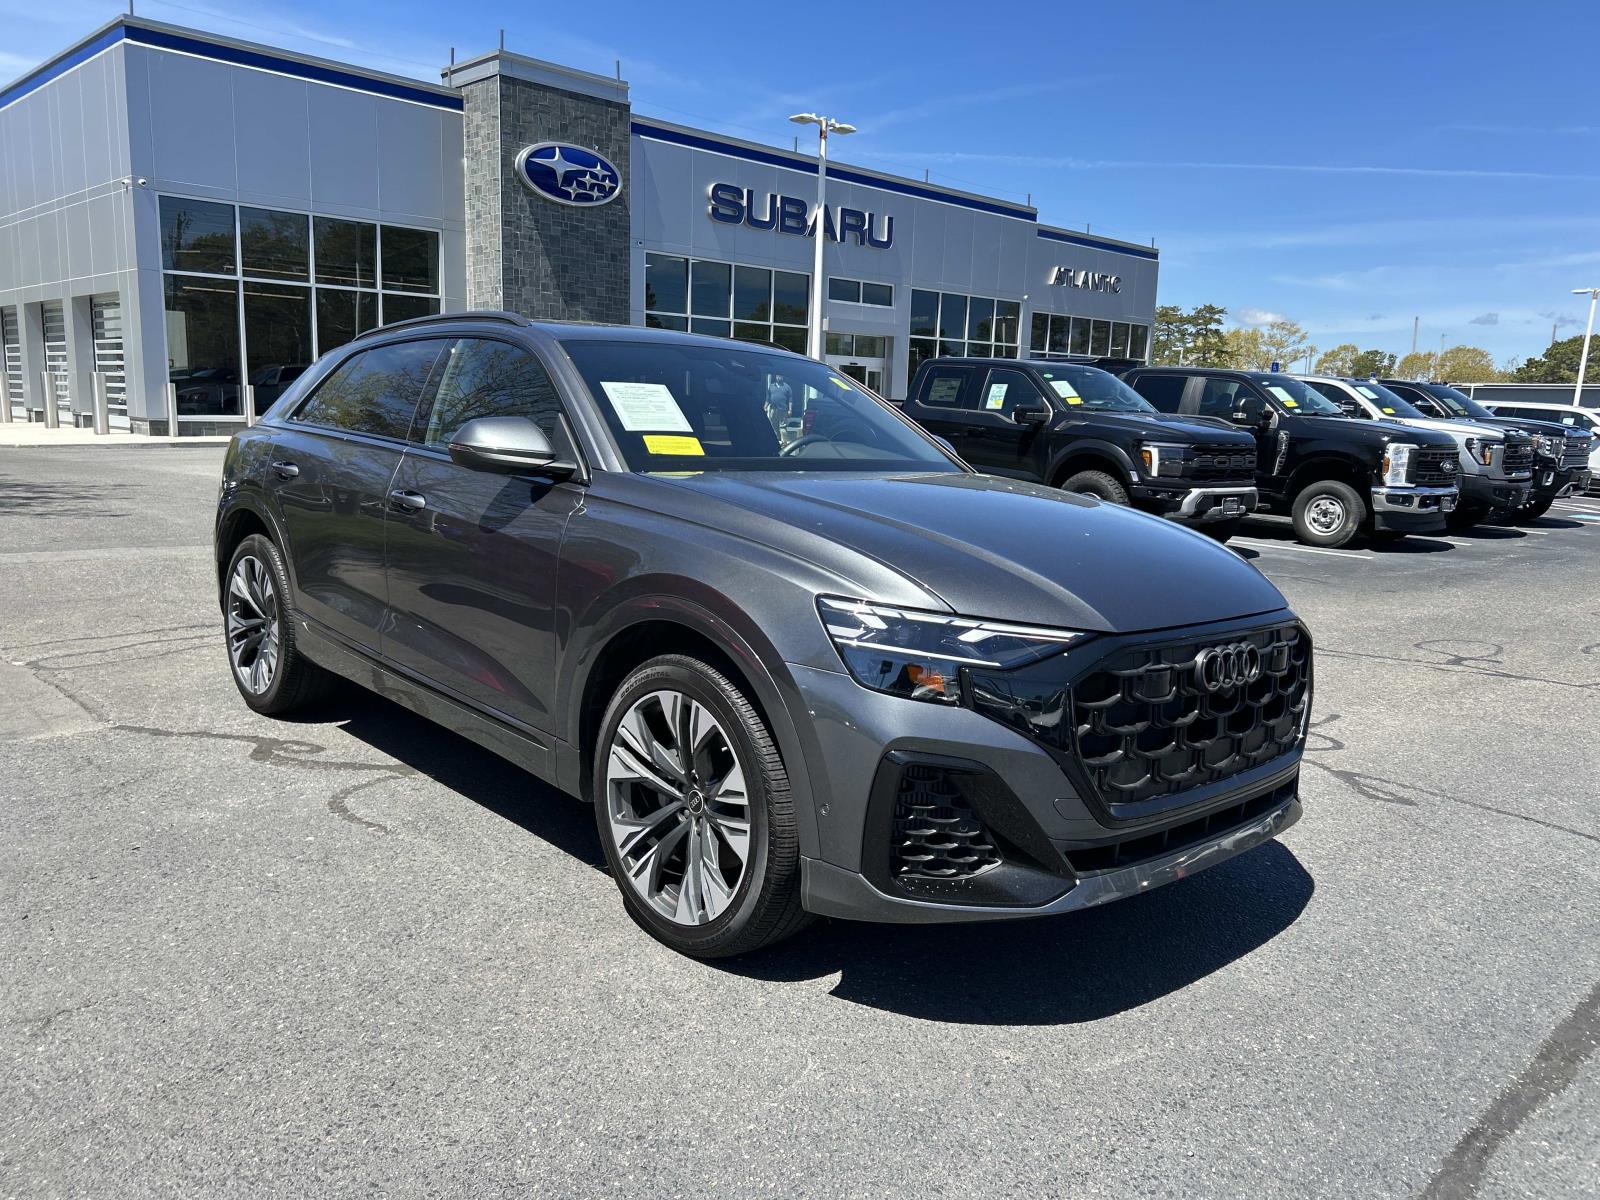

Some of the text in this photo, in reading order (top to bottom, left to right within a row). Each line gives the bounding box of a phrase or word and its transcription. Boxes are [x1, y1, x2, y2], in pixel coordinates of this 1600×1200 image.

[708, 183, 894, 249] SUBARU
[1048, 266, 1121, 294] ATLANTIC
[621, 671, 671, 698] CONTINENTAL
